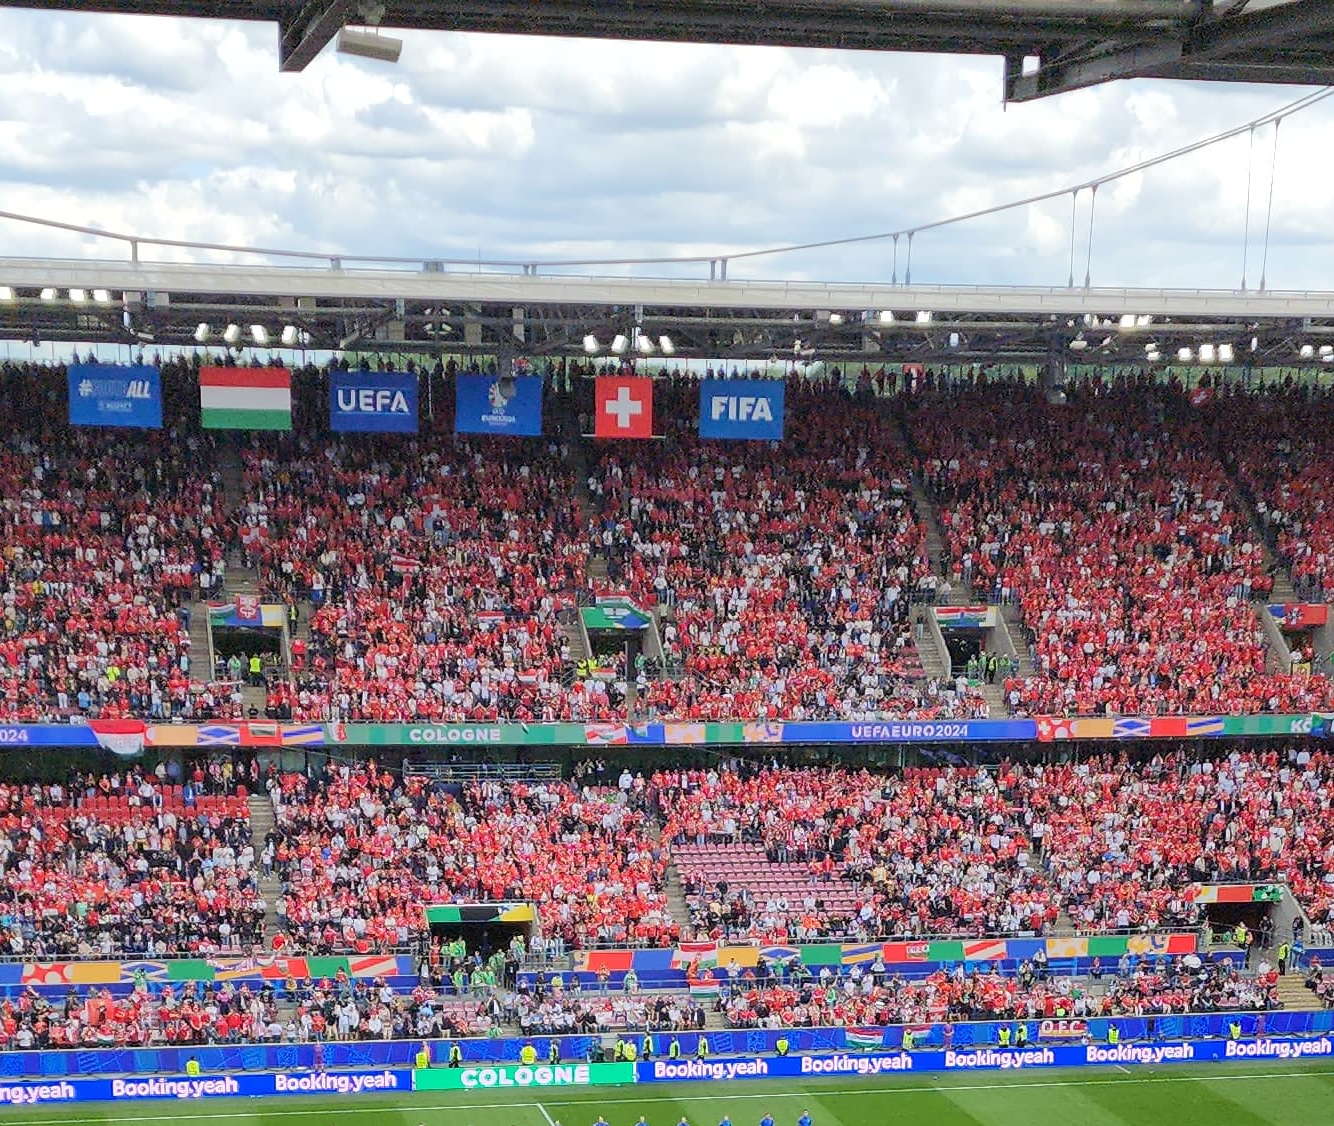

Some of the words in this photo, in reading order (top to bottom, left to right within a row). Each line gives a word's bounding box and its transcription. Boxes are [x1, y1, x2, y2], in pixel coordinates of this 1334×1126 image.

[337, 390, 409, 413] UEFA
[711, 396, 773, 422] FIFA
[409, 728, 501, 742] COLOGNE
[945, 1046, 1054, 1069] Booking.yeah
[1086, 1041, 1194, 1063] Booking.yeah
[1225, 1037, 1332, 1058] Booking.yeah
[654, 1056, 768, 1080] Booking.yeah
[801, 1050, 912, 1074] Booking.yeah
[112, 1076, 238, 1098] Booking.yeah
[275, 1068, 397, 1093] Booking.yeah
[460, 1066, 590, 1086] COLOGNE
